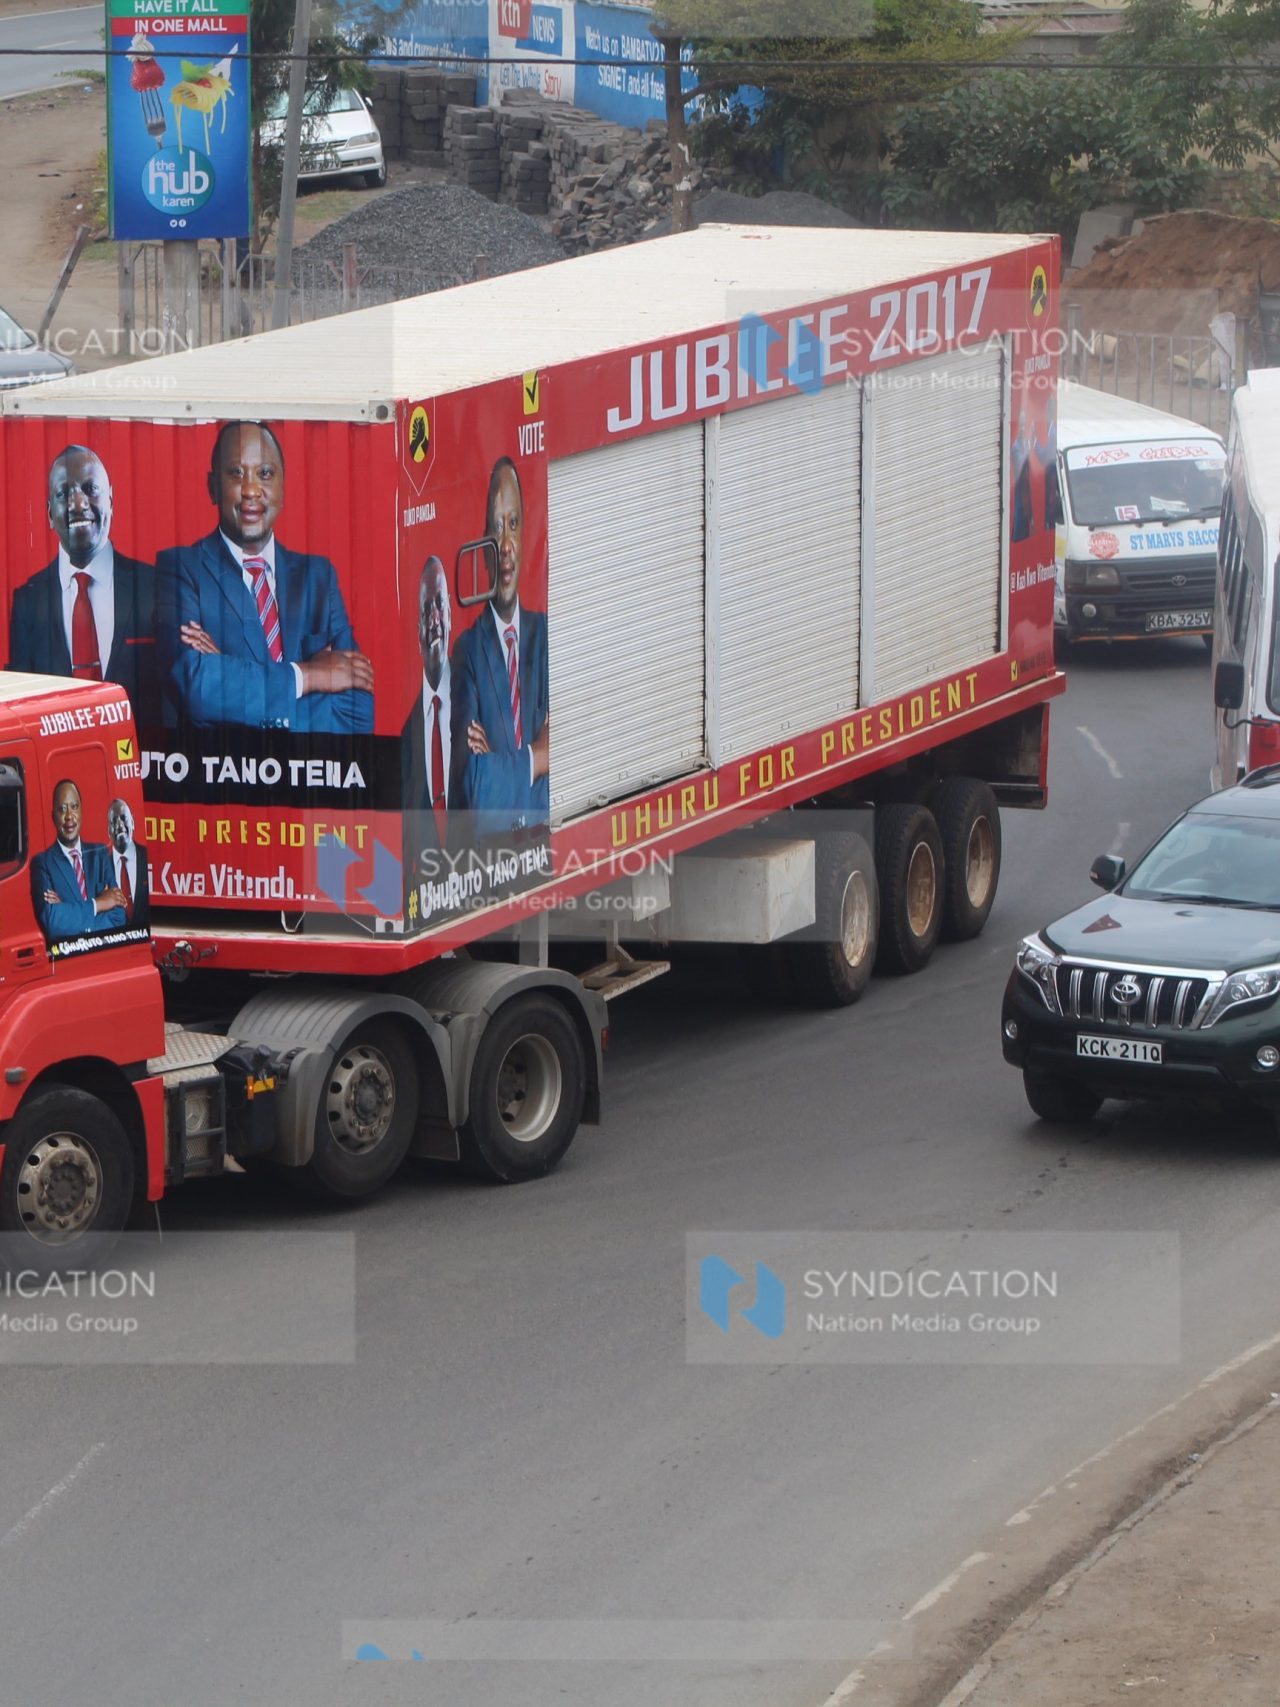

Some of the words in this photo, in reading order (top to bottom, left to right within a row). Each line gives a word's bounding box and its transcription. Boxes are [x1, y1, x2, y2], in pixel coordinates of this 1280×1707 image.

[134, 1, 172, 14] HAVE
[175, 0, 187, 12] IT
[191, 0, 218, 12] ALL
[501, 1, 520, 28] ktn
[134, 20, 149, 33] IN
[151, 19, 184, 32] ONE
[187, 18, 228, 32] MALL
[532, 15, 555, 44] NEWS
[398, 33, 414, 56] and
[585, 25, 600, 51] Watch
[602, 31, 609, 54] us
[610, 38, 619, 57] on
[543, 69, 562, 101] Story
[598, 65, 627, 93] SIGNET
[628, 73, 641, 96] and
[641, 71, 649, 97] all
[650, 72, 665, 101] free
[148, 150, 209, 195] hub
[155, 160, 175, 171] the
[162, 196, 195, 207] karen
[607, 304, 848, 433] JUBILEE
[869, 266, 992, 363] 2017
[518, 420, 545, 457] VOTE
[1119, 506, 1138, 520] 15
[1129, 533, 1144, 551] ST
[1145, 530, 1185, 550] MARYS
[1149, 614, 1174, 628] KBA
[1178, 612, 1211, 626] 325V
[39, 707, 95, 737] JUBILEE
[95, 699, 132, 726] 2017
[113, 762, 140, 780] VOTE
[201, 756, 282, 785] TANO
[288, 759, 367, 788] TENA
[610, 775, 719, 848] UHURU
[739, 745, 796, 797] FOR
[821, 671, 979, 765] PRESIDENT
[199, 818, 369, 849] PRESIDENT
[486, 856, 518, 888] TANO
[519, 843, 549, 876] TENA
[104, 932, 127, 945] TANO
[126, 928, 149, 940] TENA
[1079, 1038, 1110, 1057] KCK
[1119, 1042, 1160, 1062] 211Q
